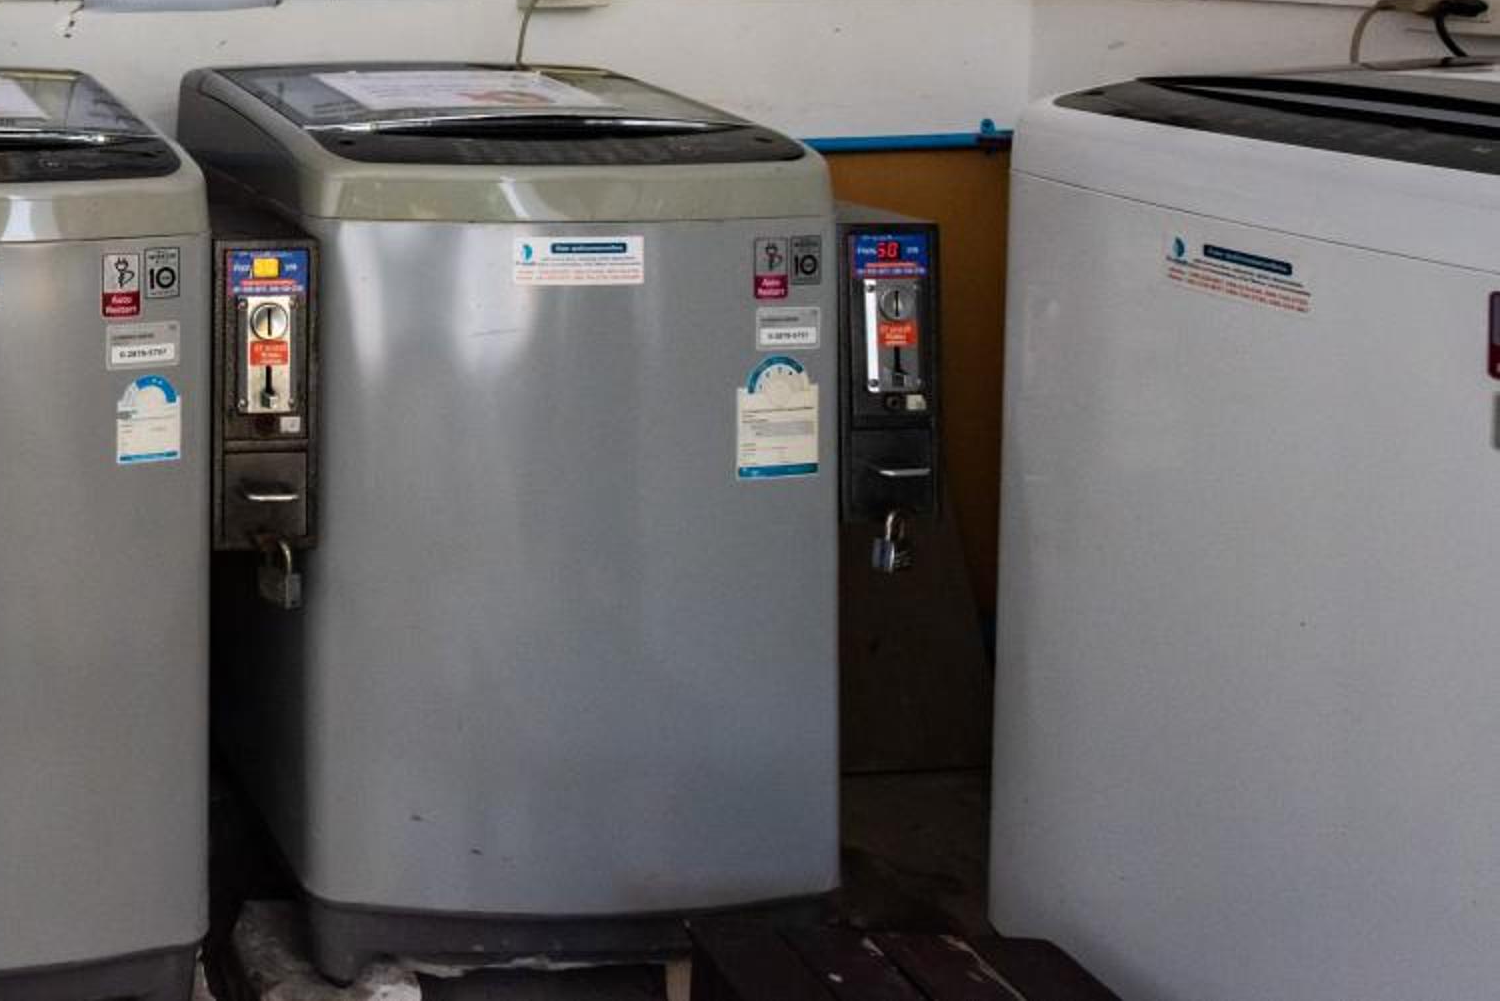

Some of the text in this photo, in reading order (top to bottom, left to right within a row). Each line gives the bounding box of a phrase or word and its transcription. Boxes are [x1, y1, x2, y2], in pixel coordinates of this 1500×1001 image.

[876, 241, 900, 259] 50
[795, 254, 819, 277] 10
[149, 265, 177, 291] 10
[761, 277, 782, 288] Auto
[756, 286, 786, 298] Restart
[110, 295, 133, 306] Auto
[104, 304, 138, 316] Restart
